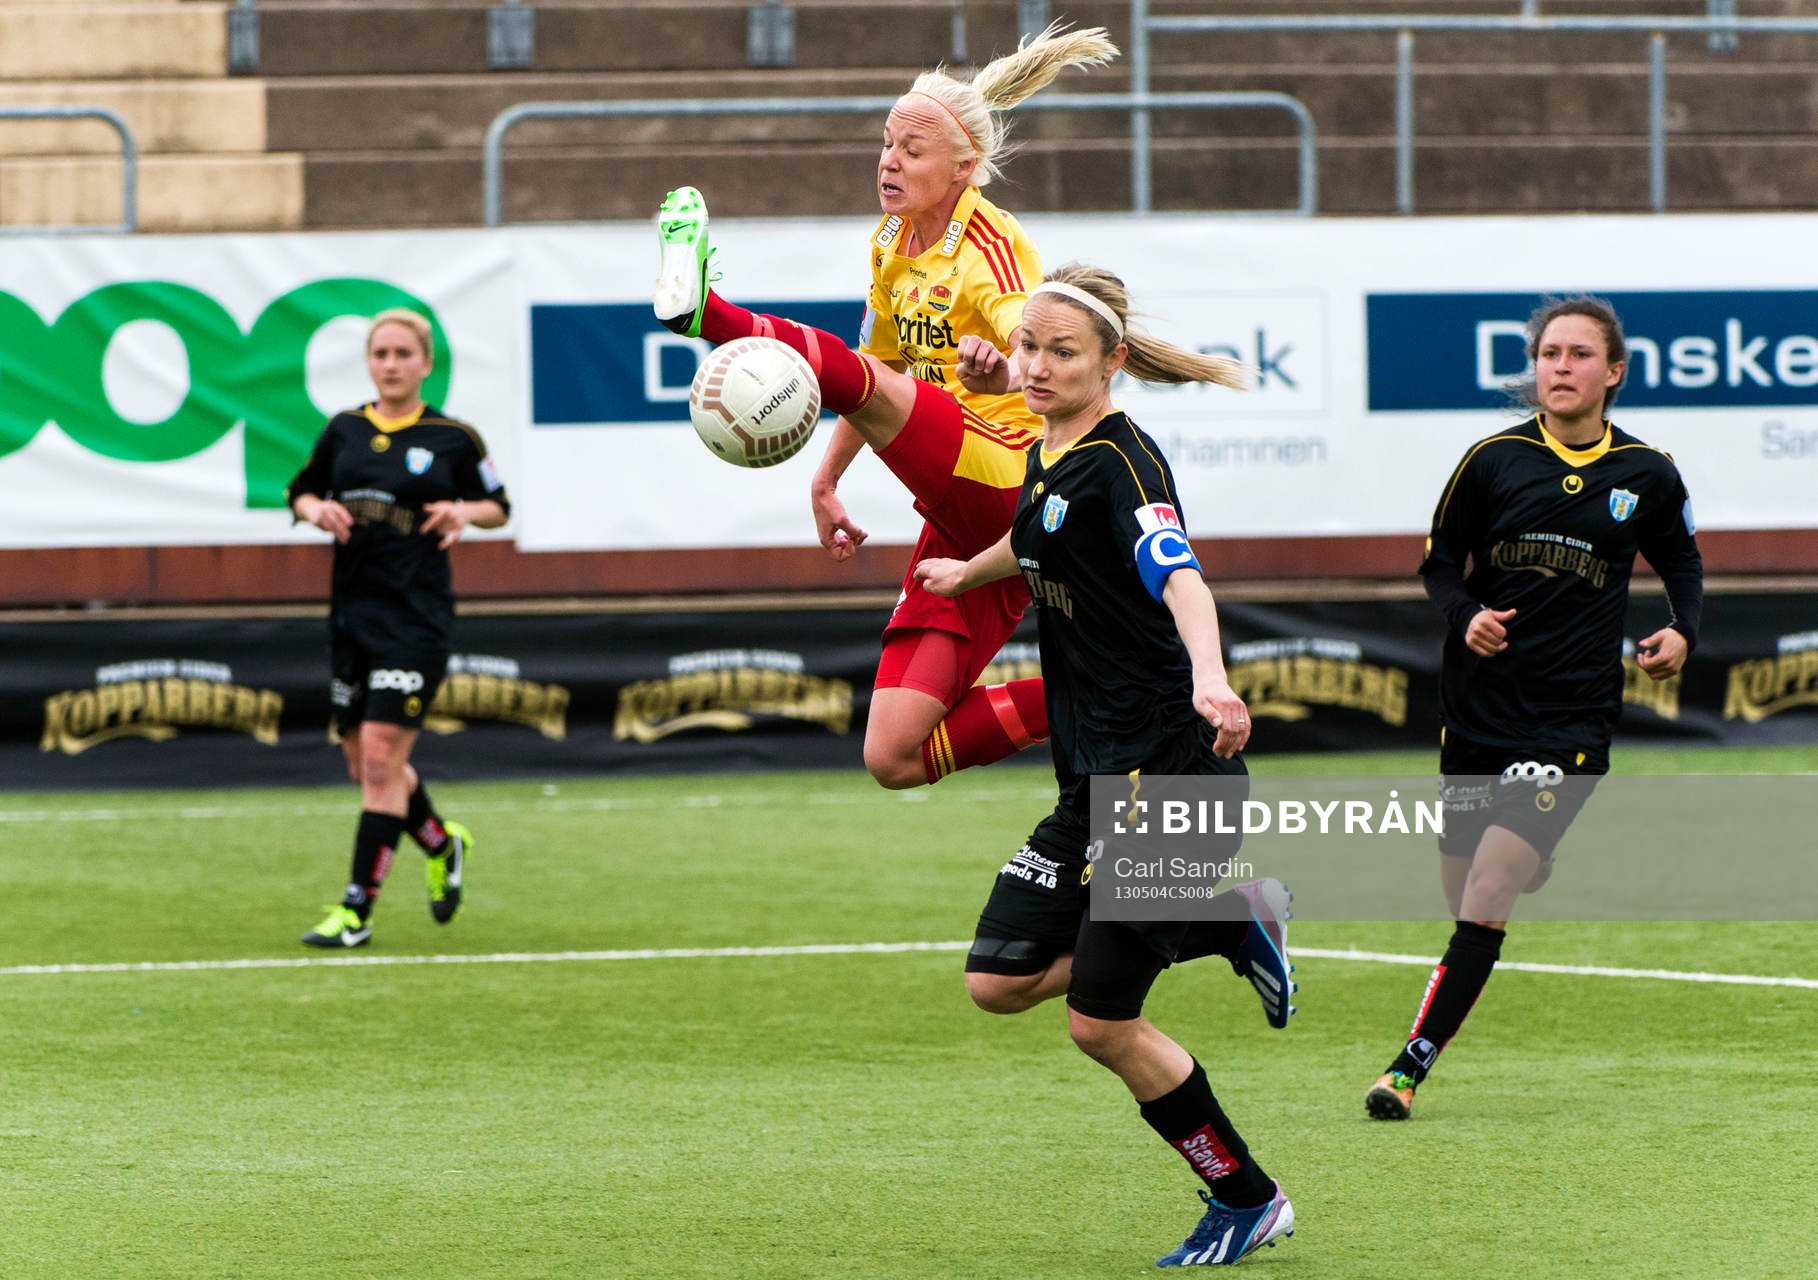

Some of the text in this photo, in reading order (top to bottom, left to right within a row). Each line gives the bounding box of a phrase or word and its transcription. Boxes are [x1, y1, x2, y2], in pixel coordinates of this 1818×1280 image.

[1476, 318, 1818, 390] Dnske
[751, 377, 799, 425] uhlsport
[1168, 431, 1328, 467] hamnen
[1566, 537, 1592, 551] CIDER
[1035, 873, 1057, 889] AB
